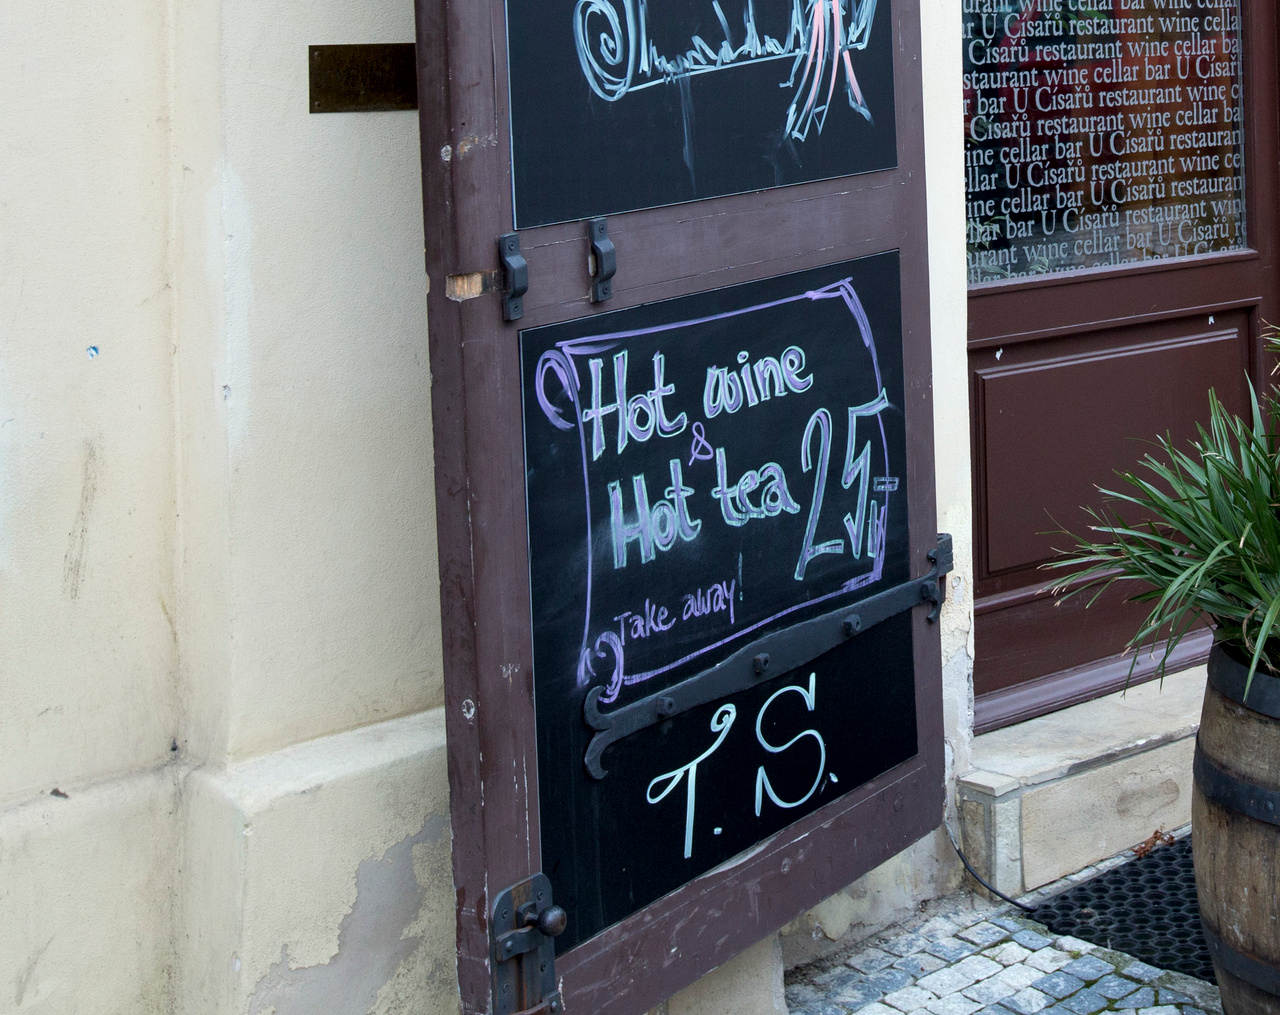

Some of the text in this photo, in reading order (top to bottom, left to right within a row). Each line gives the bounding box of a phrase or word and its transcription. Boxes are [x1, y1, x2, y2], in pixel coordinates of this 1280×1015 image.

[982, 11, 1199, 39] U Císařů restaurant wine
[582, 346, 814, 462] Hot wine
[608, 459, 702, 570] Hot
[714, 448, 801, 528] tea
[613, 598, 677, 646] Take
